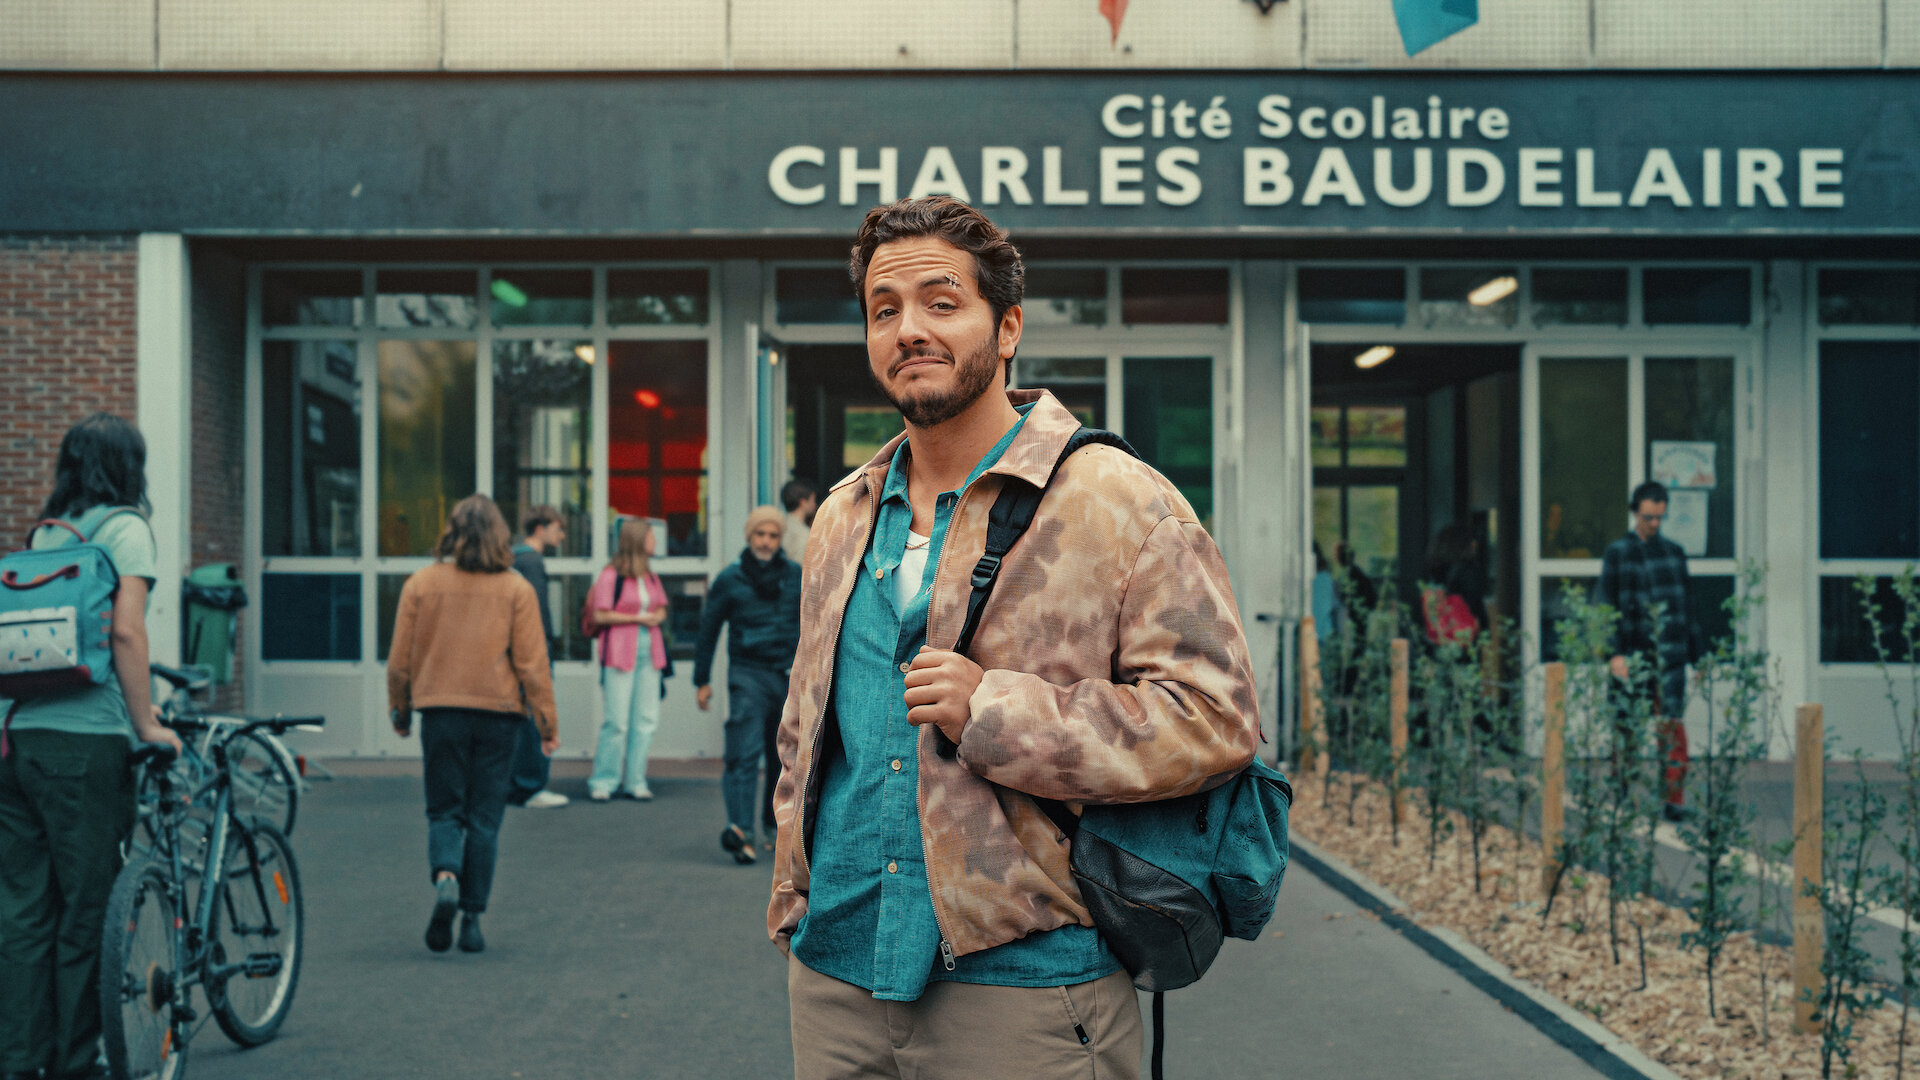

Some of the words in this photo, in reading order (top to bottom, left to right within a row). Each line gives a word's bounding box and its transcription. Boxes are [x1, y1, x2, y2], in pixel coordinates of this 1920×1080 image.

[1102, 94, 1232, 138] Cité
[1258, 94, 1510, 139] Scolaire
[768, 145, 1202, 205] CHARLES
[1243, 147, 1844, 206] BAUDELAIRE
